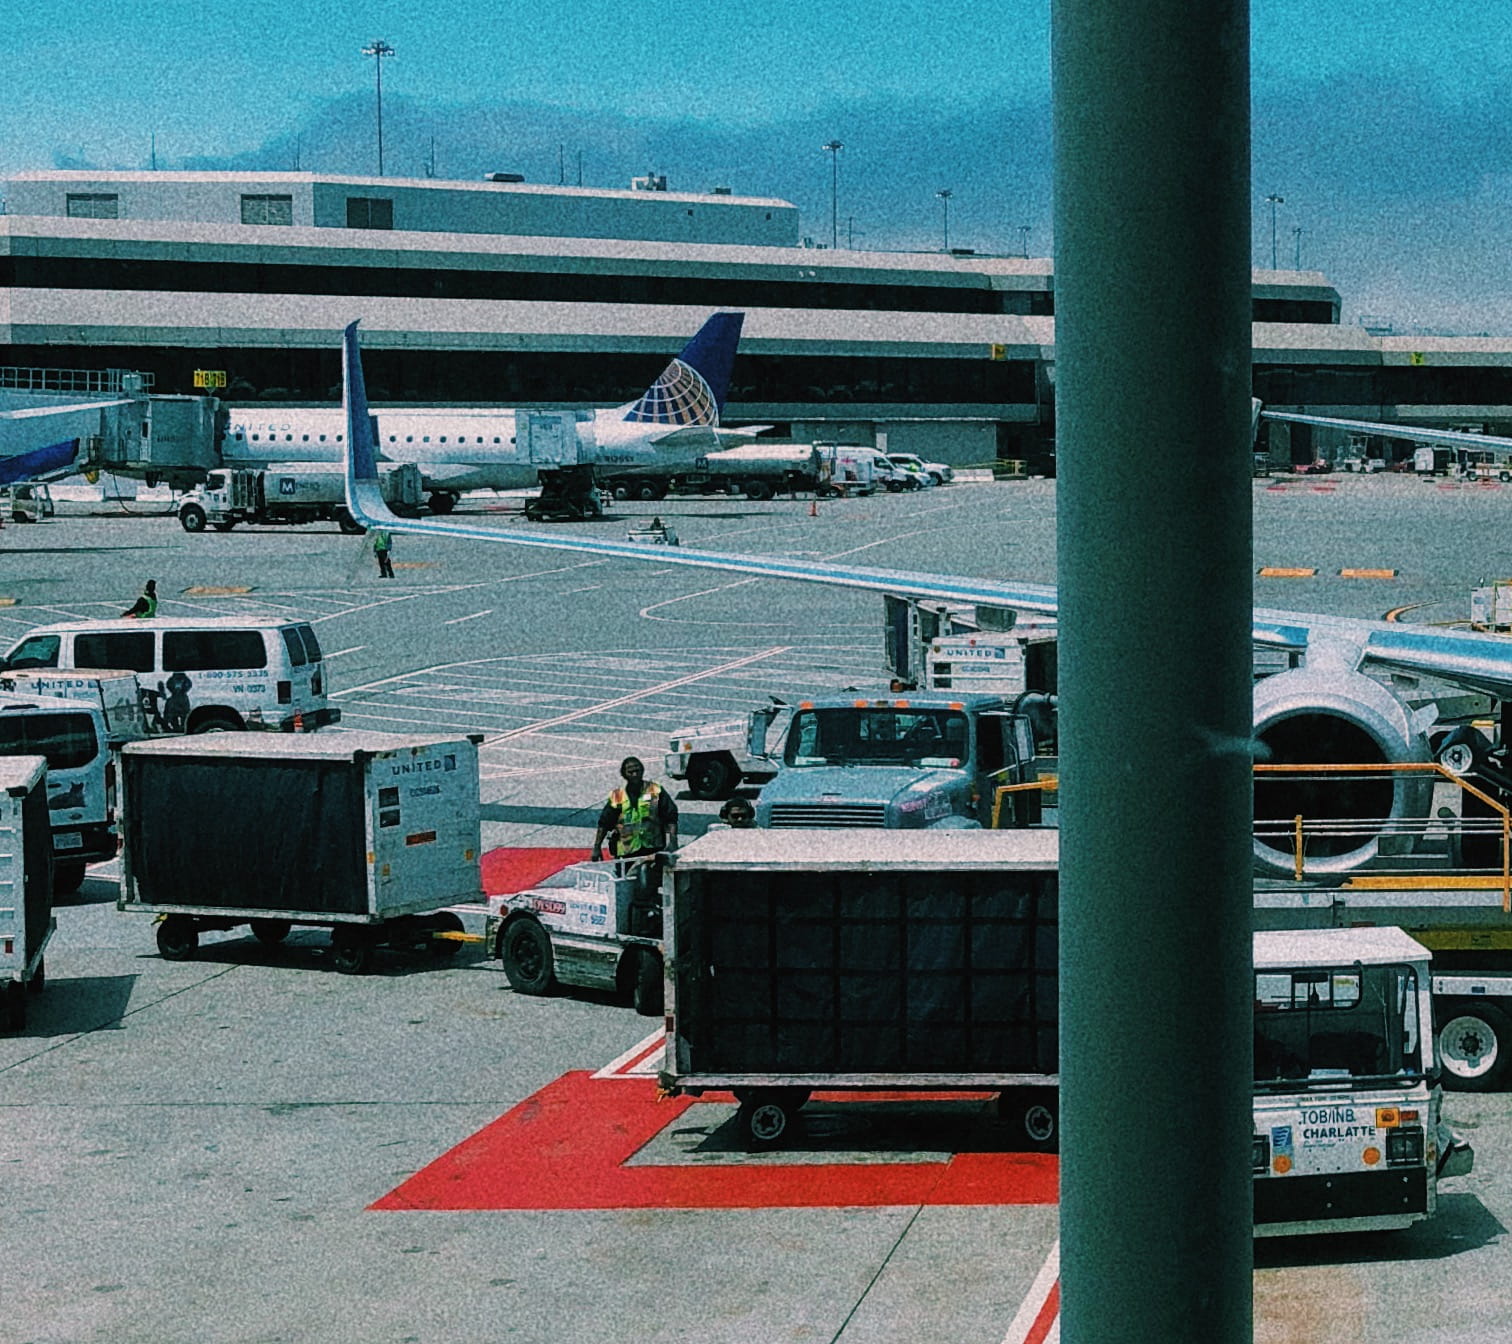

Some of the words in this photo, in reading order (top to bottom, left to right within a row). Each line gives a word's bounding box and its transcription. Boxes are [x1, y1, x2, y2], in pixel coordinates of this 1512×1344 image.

[947, 649, 992, 657] UNITED
[31, 680, 84, 689] UNITED
[391, 759, 442, 776] UNITED
[1303, 1126, 1376, 1139] CHARLATTE
